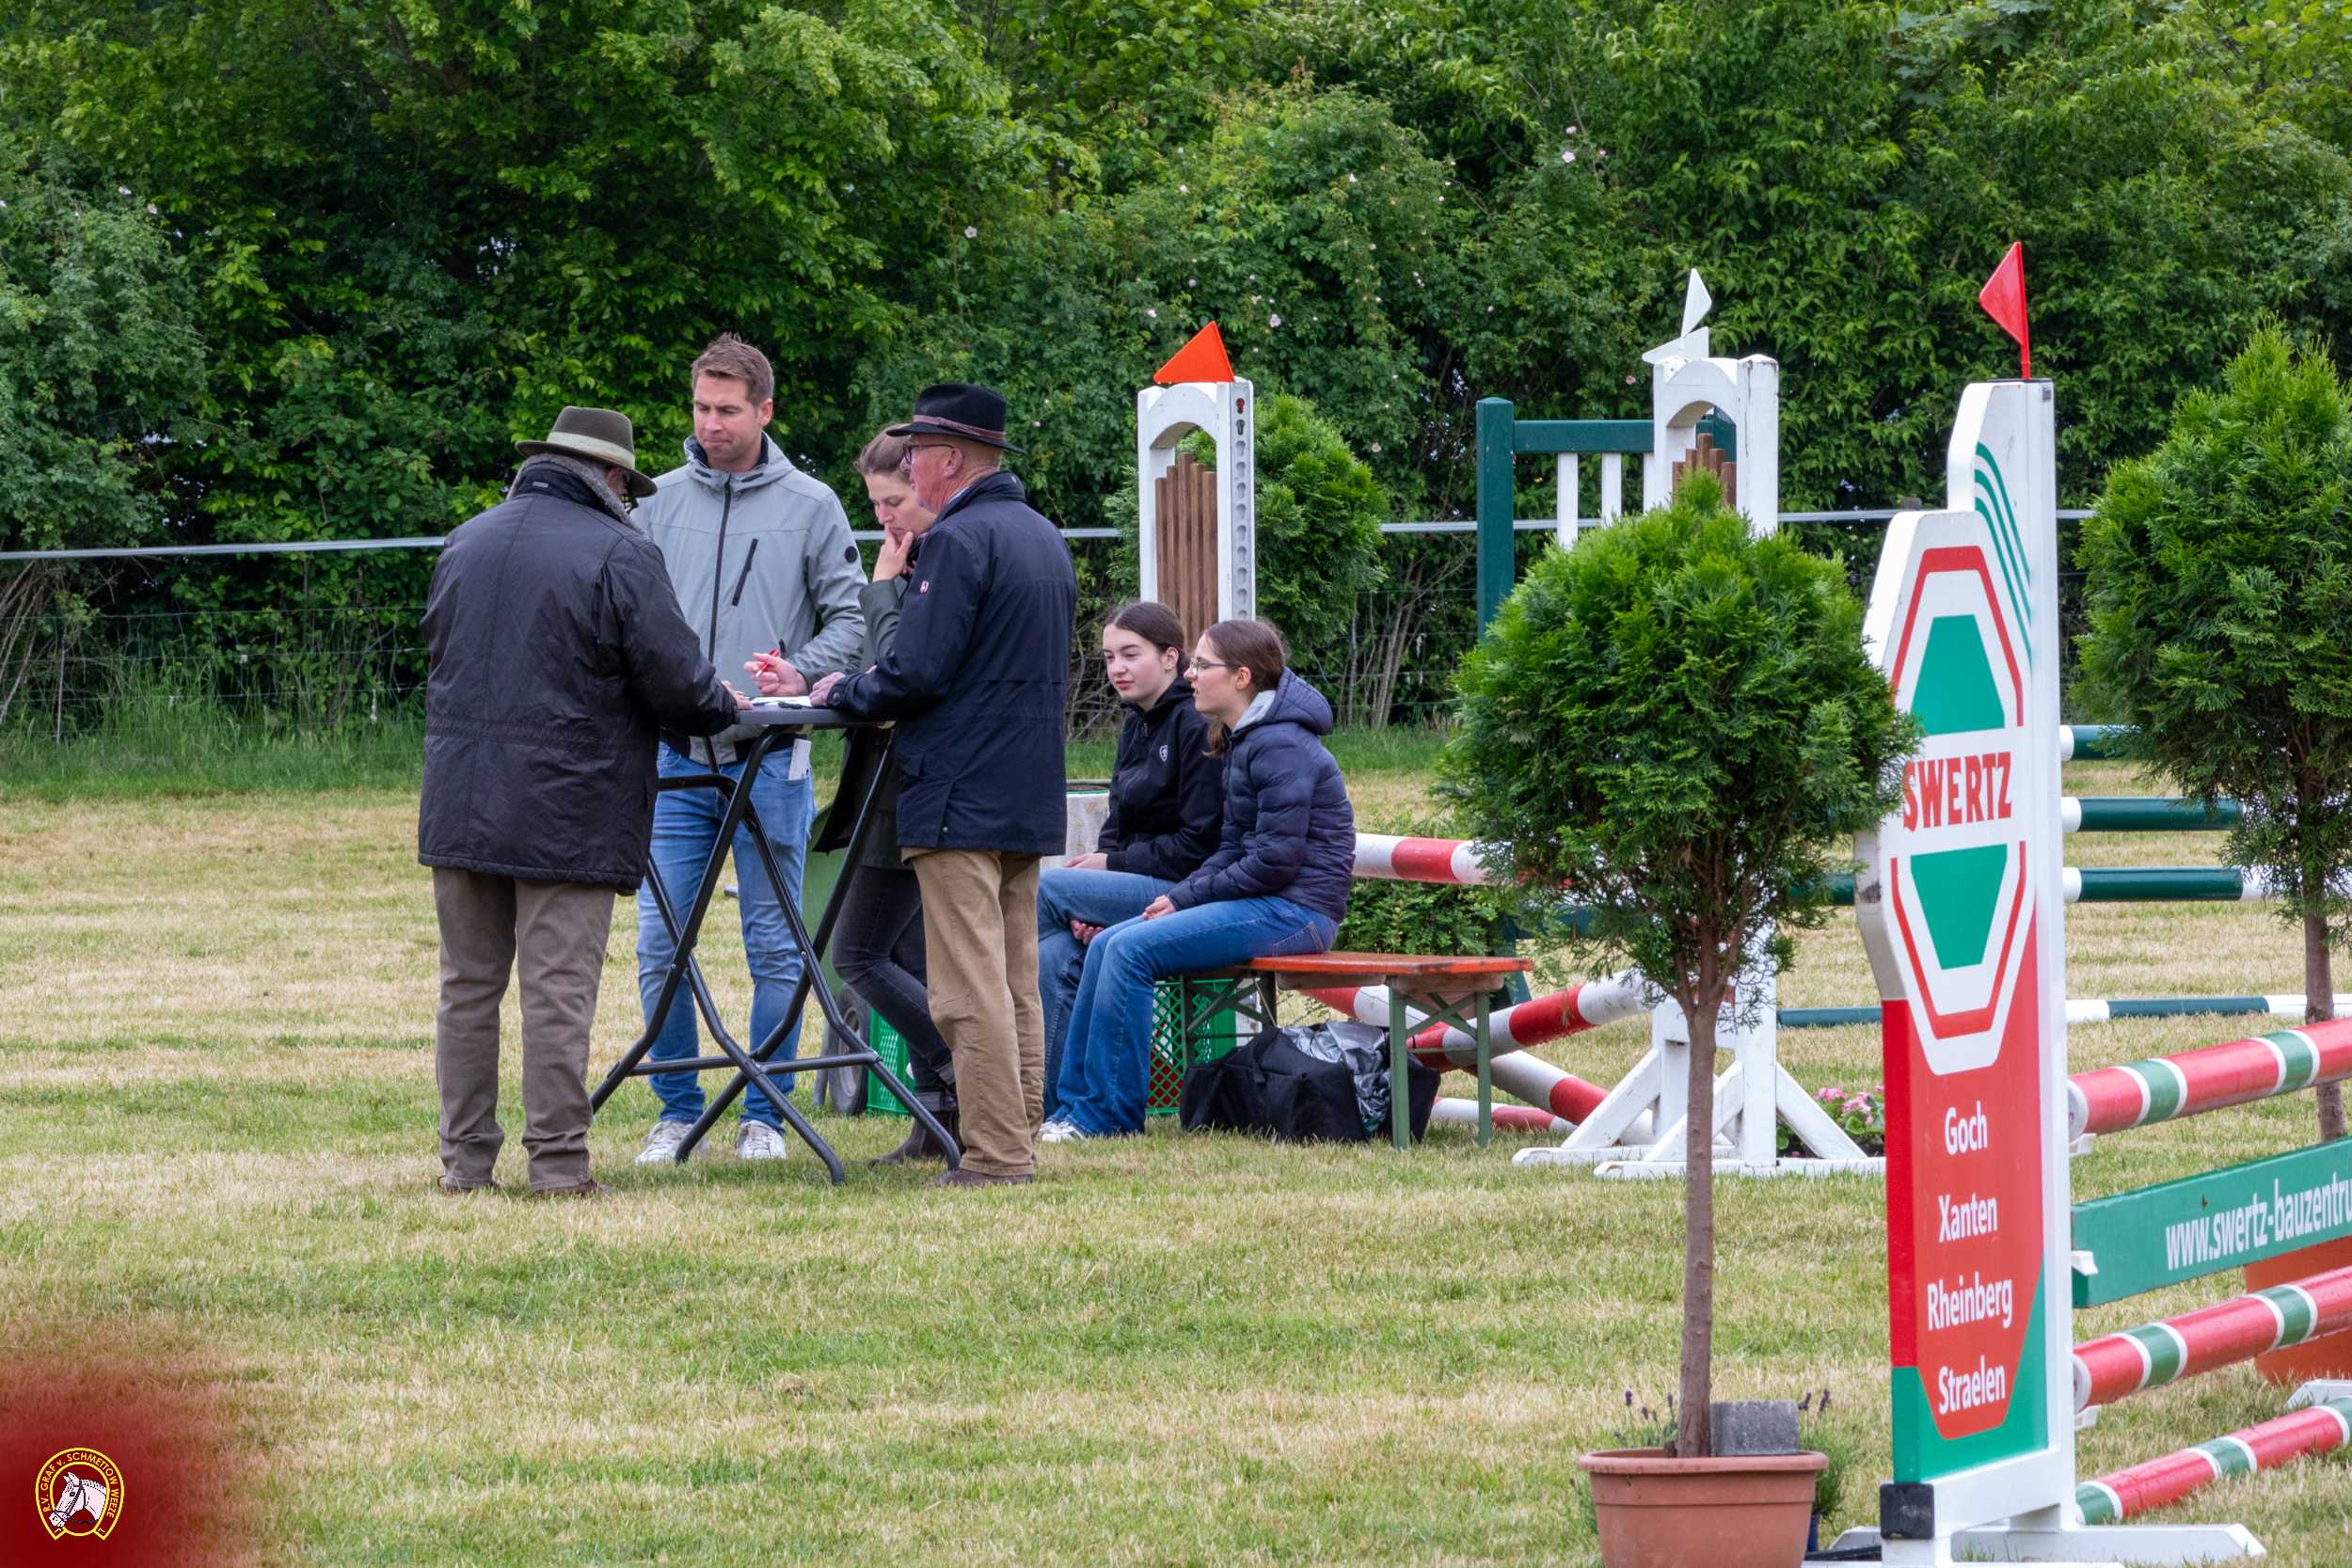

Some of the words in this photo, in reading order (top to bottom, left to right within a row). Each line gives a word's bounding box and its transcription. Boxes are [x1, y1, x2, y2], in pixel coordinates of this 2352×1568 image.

[1902, 752, 2011, 832] SWERTZ
[1944, 1100, 1988, 1156] Goch
[1938, 1193, 1998, 1243] Xanten
[1927, 1270, 2013, 1331] Rheinberg
[1938, 1354, 2006, 1416] Straelen
